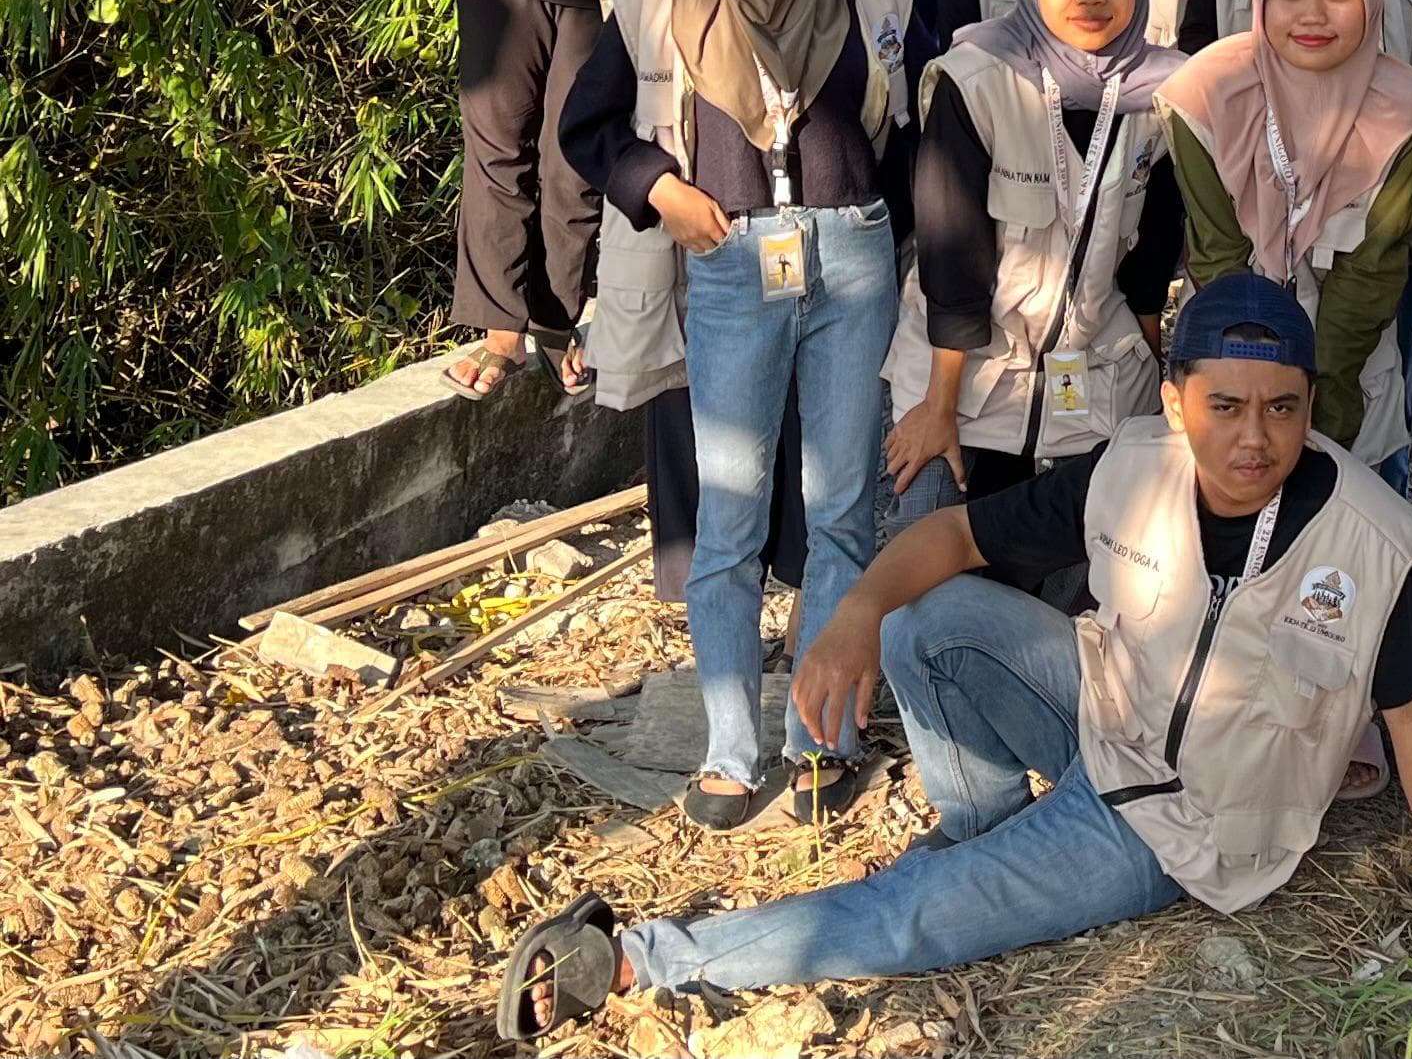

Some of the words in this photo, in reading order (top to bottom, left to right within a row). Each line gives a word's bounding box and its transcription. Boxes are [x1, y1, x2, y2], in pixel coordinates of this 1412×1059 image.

[1091, 91, 1113, 142] UNIGORO
[1112, 542, 1129, 558] LEO
[1128, 548, 1151, 569] YOGA
